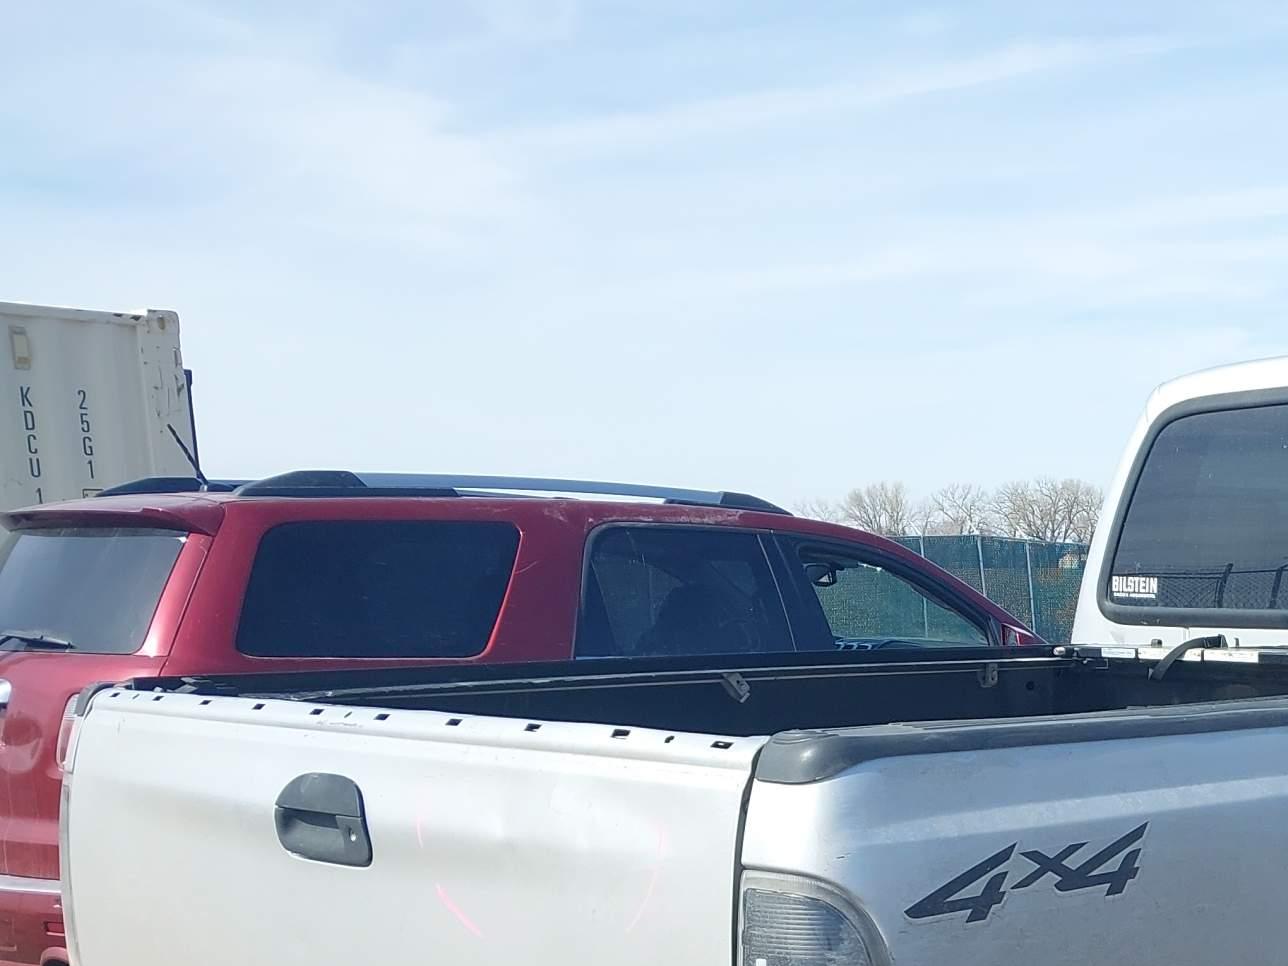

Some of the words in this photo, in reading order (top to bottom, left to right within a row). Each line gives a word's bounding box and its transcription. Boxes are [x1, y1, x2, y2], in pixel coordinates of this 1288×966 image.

[20, 386, 41, 478] KDCU
[77, 390, 94, 479] 25G1
[1112, 575, 1158, 593] BILSTEIN
